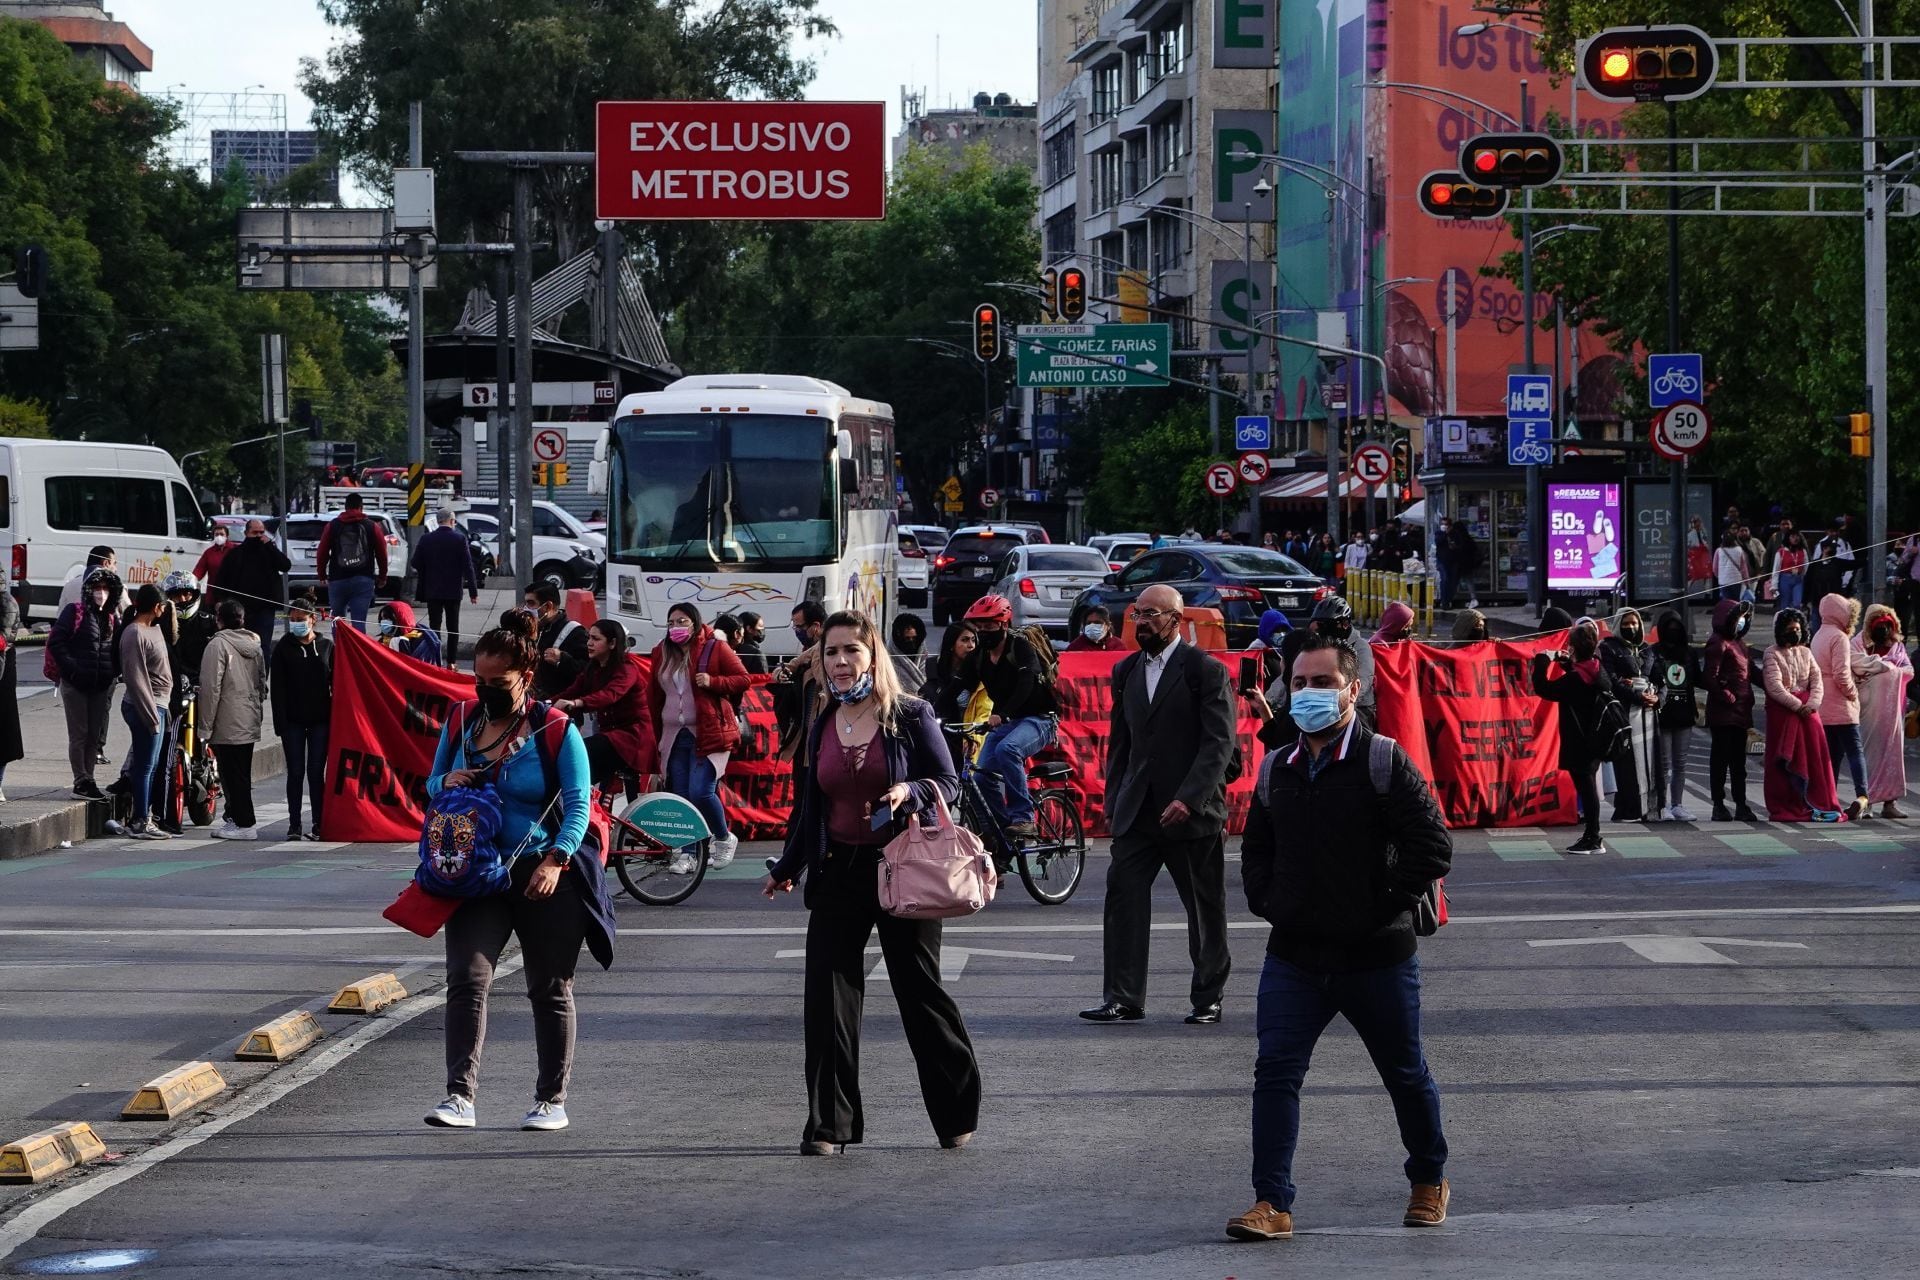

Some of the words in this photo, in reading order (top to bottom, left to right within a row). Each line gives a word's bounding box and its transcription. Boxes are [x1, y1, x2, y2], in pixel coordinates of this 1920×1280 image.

[1438, 6, 1498, 71] los
[630, 121, 851, 151] EXCLUSIVO
[631, 170, 850, 199] METROBUS
[1479, 285, 1555, 319] Spofy
[1058, 340, 1105, 352] GOMEZ
[1112, 339, 1157, 351] FARIAS
[1029, 370, 1085, 382] ANTONIO
[1092, 369, 1127, 382] CASO
[1674, 412, 1698, 428] 50
[1524, 423, 1536, 437] E
[1673, 430, 1698, 440] km/h
[1559, 489, 1596, 497] REBAJAS
[1551, 512, 1585, 530] 50%
[1554, 549, 1563, 560] 9
[1569, 549, 1583, 560] 12
[1461, 706, 1536, 761] SERÉ
[334, 748, 428, 810] PRIVA
